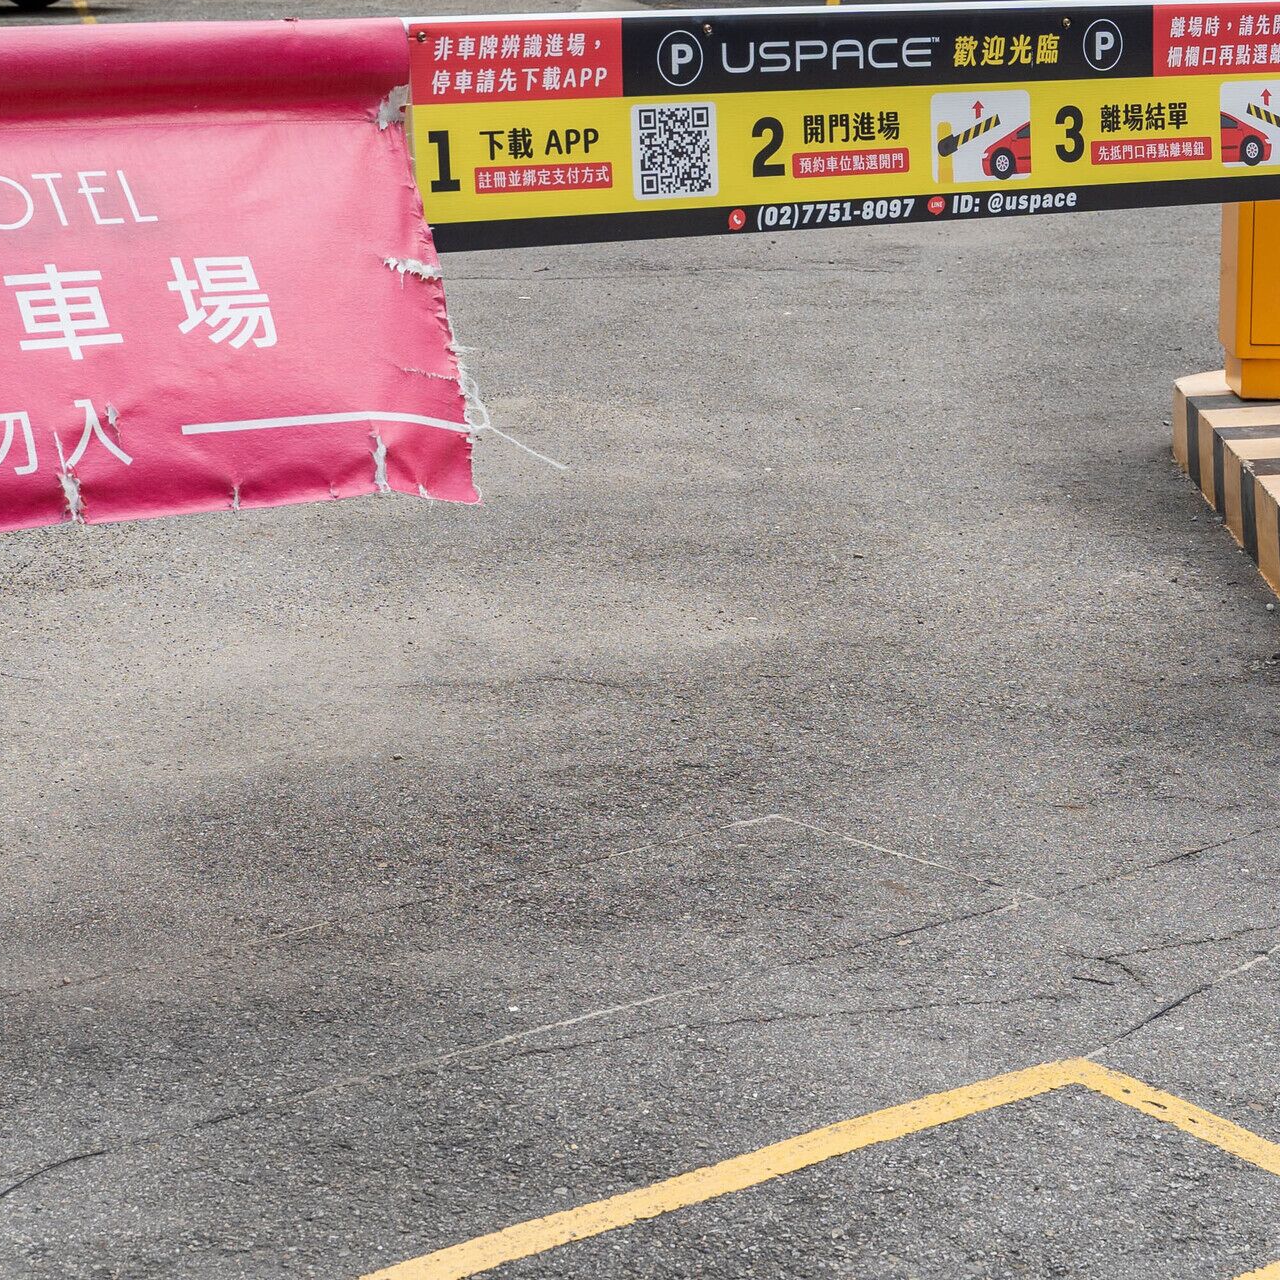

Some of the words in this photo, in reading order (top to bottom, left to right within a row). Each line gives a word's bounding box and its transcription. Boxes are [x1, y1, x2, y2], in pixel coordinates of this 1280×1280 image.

[671, 43, 693, 75] P
[953, 33, 1060, 67] 歡迎光臨
[1095, 31, 1115, 61] P
[803, 111, 900, 145] 開門進場
[1055, 105, 1085, 163] 3
[1100, 102, 1188, 133] 離場結單
[479, 128, 533, 161] 下載
[545, 128, 600, 155] APP
[751, 116, 786, 178] 2
[428, 130, 461, 193] 1
[478, 166, 610, 189] 註冊並綁定支付方式
[799, 152, 904, 174] 預約車位點選開門
[757, 198, 915, 231] (02)7751-8097
[952, 194, 980, 213] ID:
[987, 192, 1077, 214] @uspace
